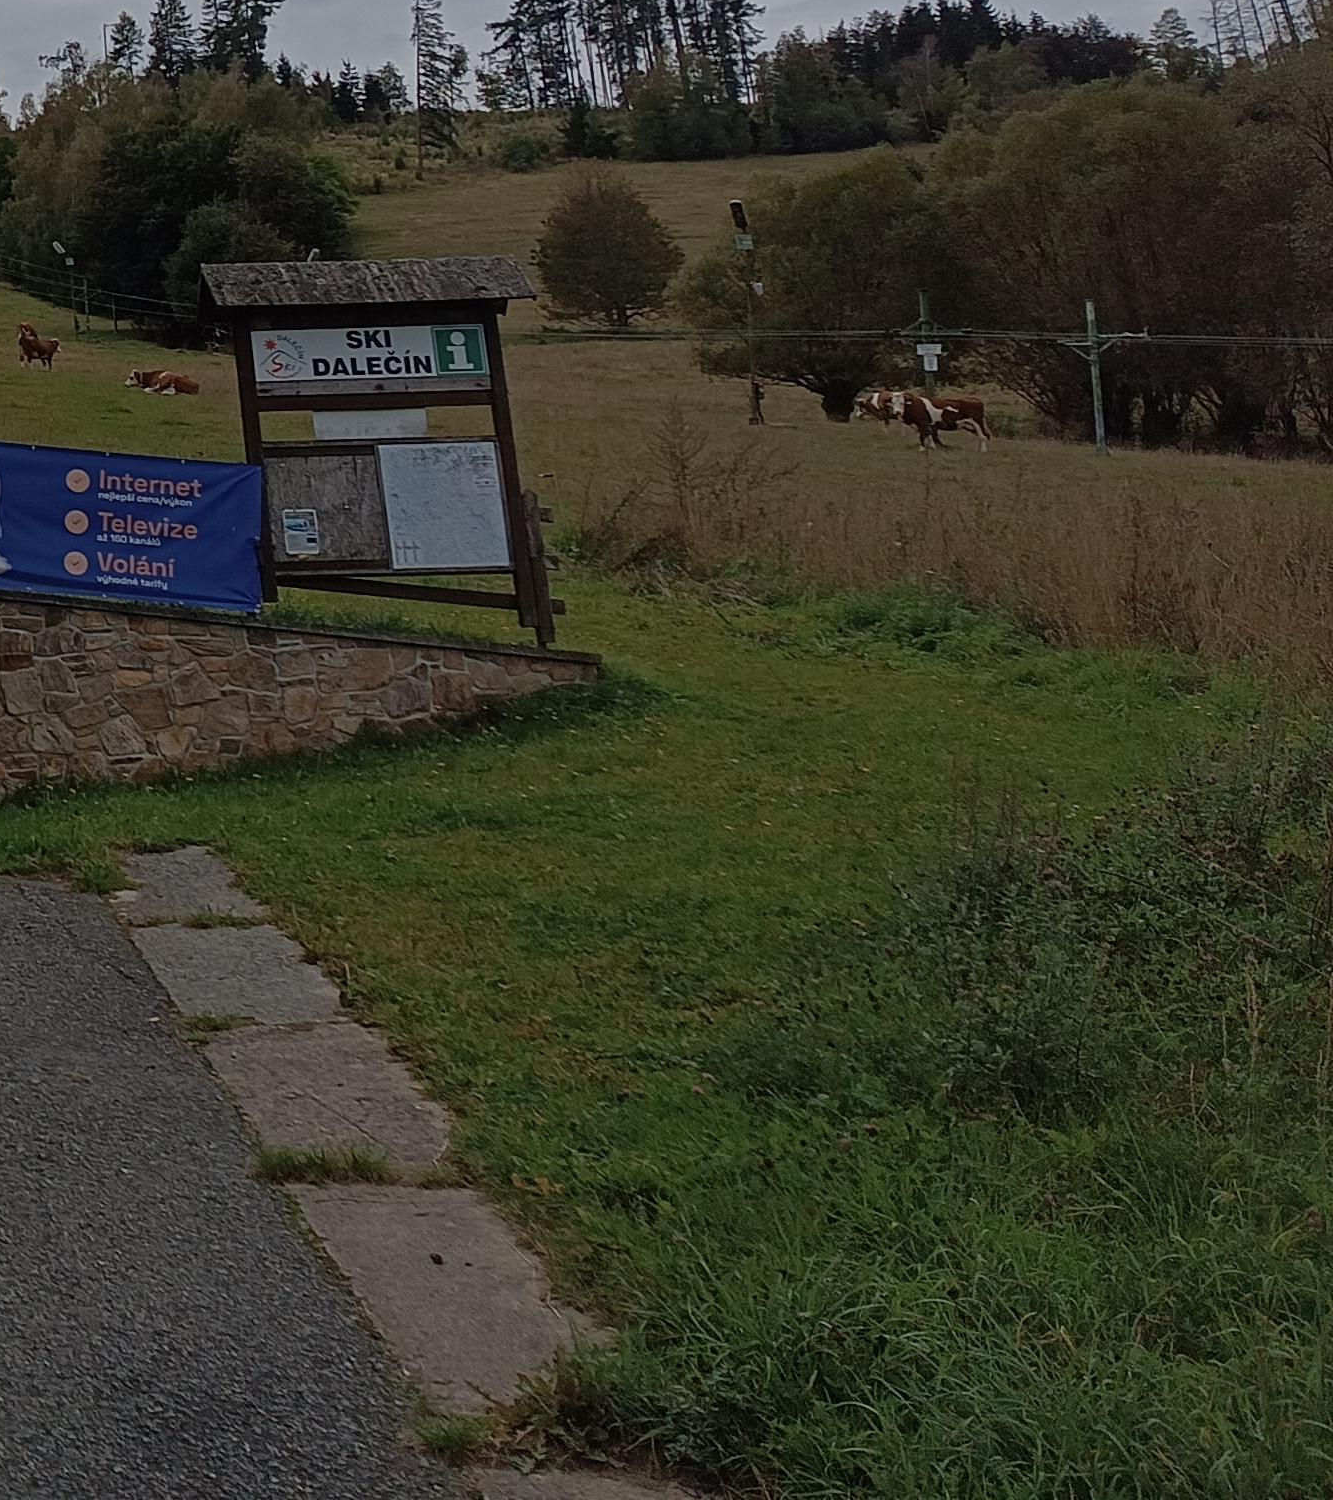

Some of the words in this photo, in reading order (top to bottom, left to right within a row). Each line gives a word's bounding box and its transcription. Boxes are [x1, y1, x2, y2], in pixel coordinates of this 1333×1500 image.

[345, 329, 392, 350] SKI
[311, 350, 433, 377] DALEČÍN
[99, 469, 202, 498] Internet
[97, 511, 198, 540] Televize
[96, 551, 176, 578] Volání
